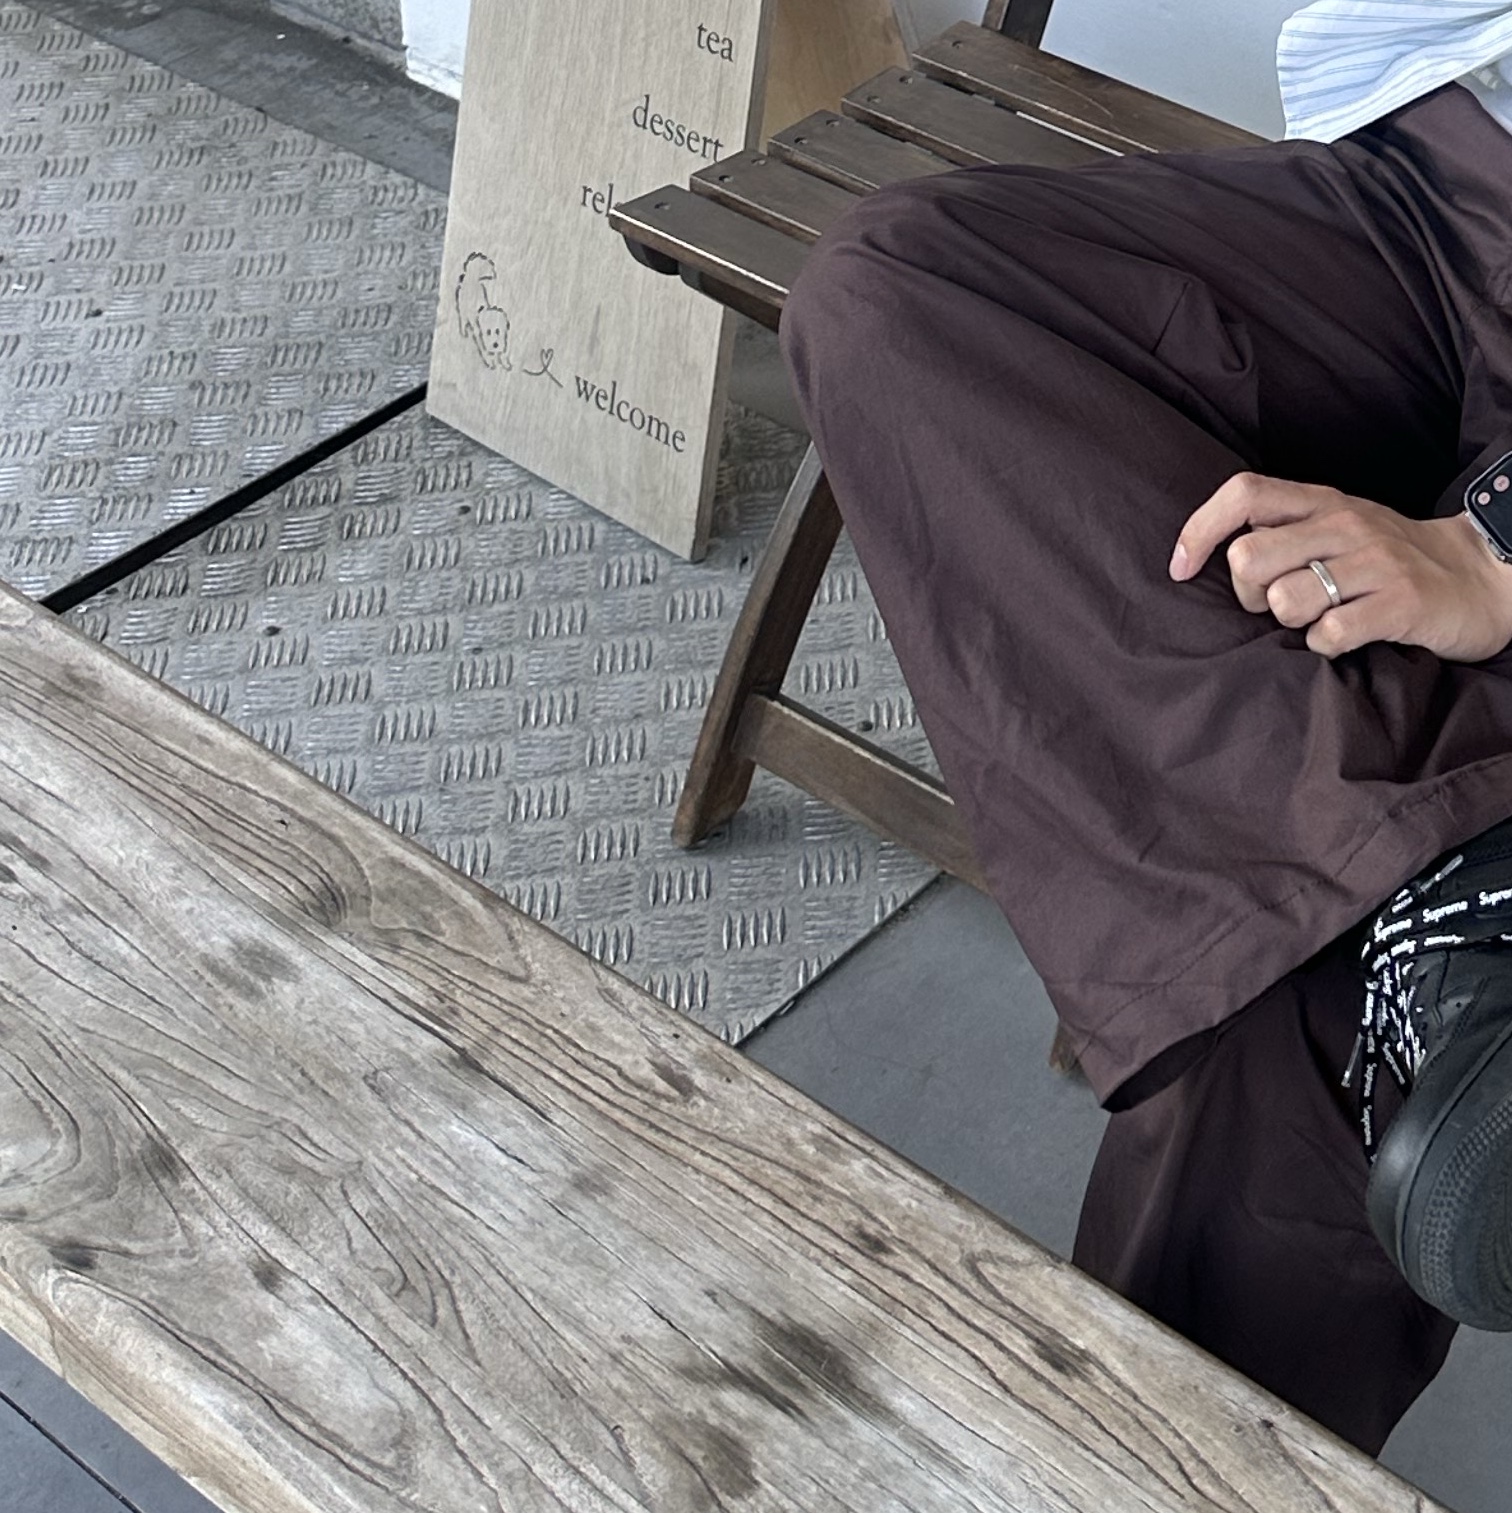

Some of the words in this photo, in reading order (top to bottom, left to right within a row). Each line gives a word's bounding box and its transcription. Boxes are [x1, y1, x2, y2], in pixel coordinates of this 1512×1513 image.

[697, 23, 734, 62] tea
[632, 94, 724, 164] dessert
[581, 182, 624, 218] rel
[574, 375, 687, 453] welcome
